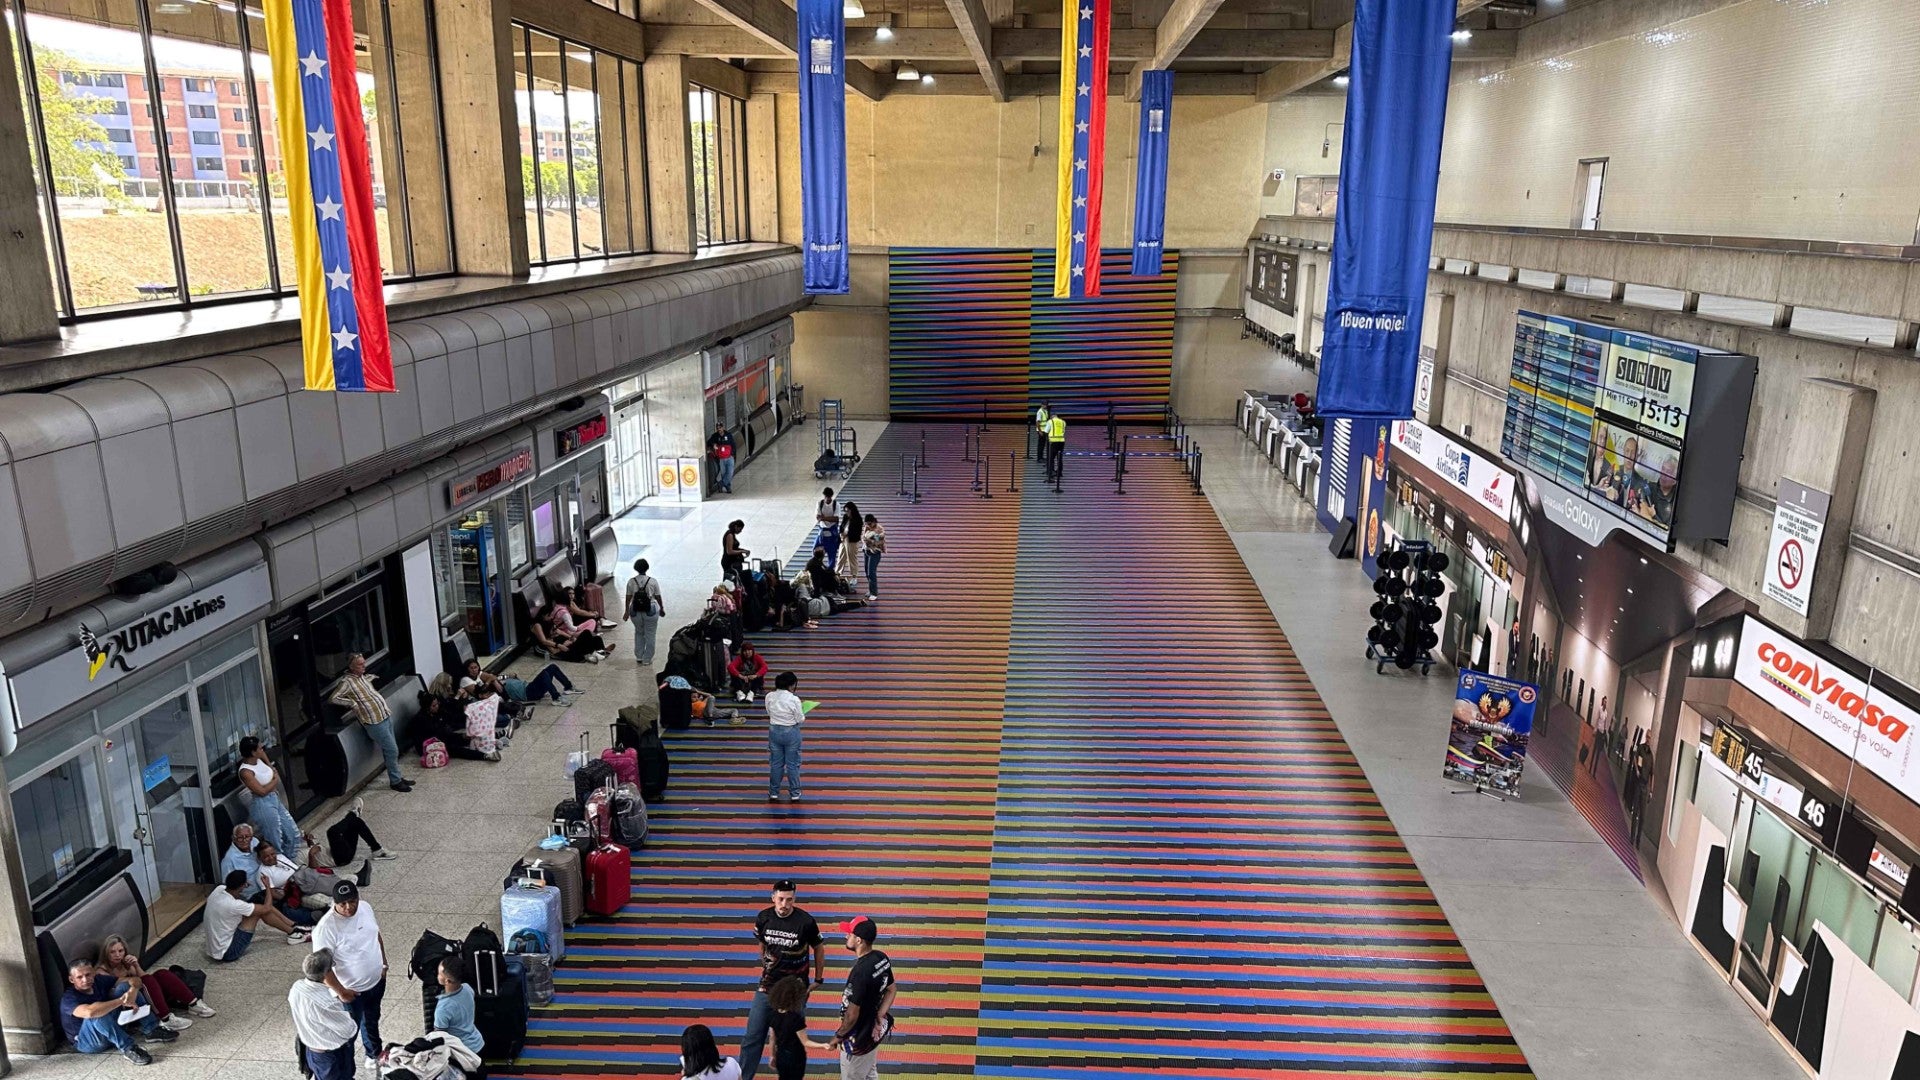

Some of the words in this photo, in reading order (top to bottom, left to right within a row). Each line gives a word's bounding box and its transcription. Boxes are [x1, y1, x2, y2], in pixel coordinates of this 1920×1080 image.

[811, 64, 832, 75] IAIM
[1340, 311, 1373, 329] ¡Buen
[1375, 314, 1406, 332] viaje!
[1616, 356, 1672, 394] SINIV
[1626, 396, 1638, 408] Sep
[1639, 397, 1682, 428] 15:13
[1445, 443, 1460, 464] Copa
[1436, 456, 1458, 481] Airlines
[1482, 487, 1504, 509] IBERIA
[1565, 498, 1601, 540] Galaxy
[1814, 703, 1822, 714] El
[1822, 707, 1851, 733] placer
[1854, 727, 1867, 742] de
[1869, 738, 1893, 759] volar
[1744, 752, 1763, 779] 45
[1803, 798, 1826, 828] 46
